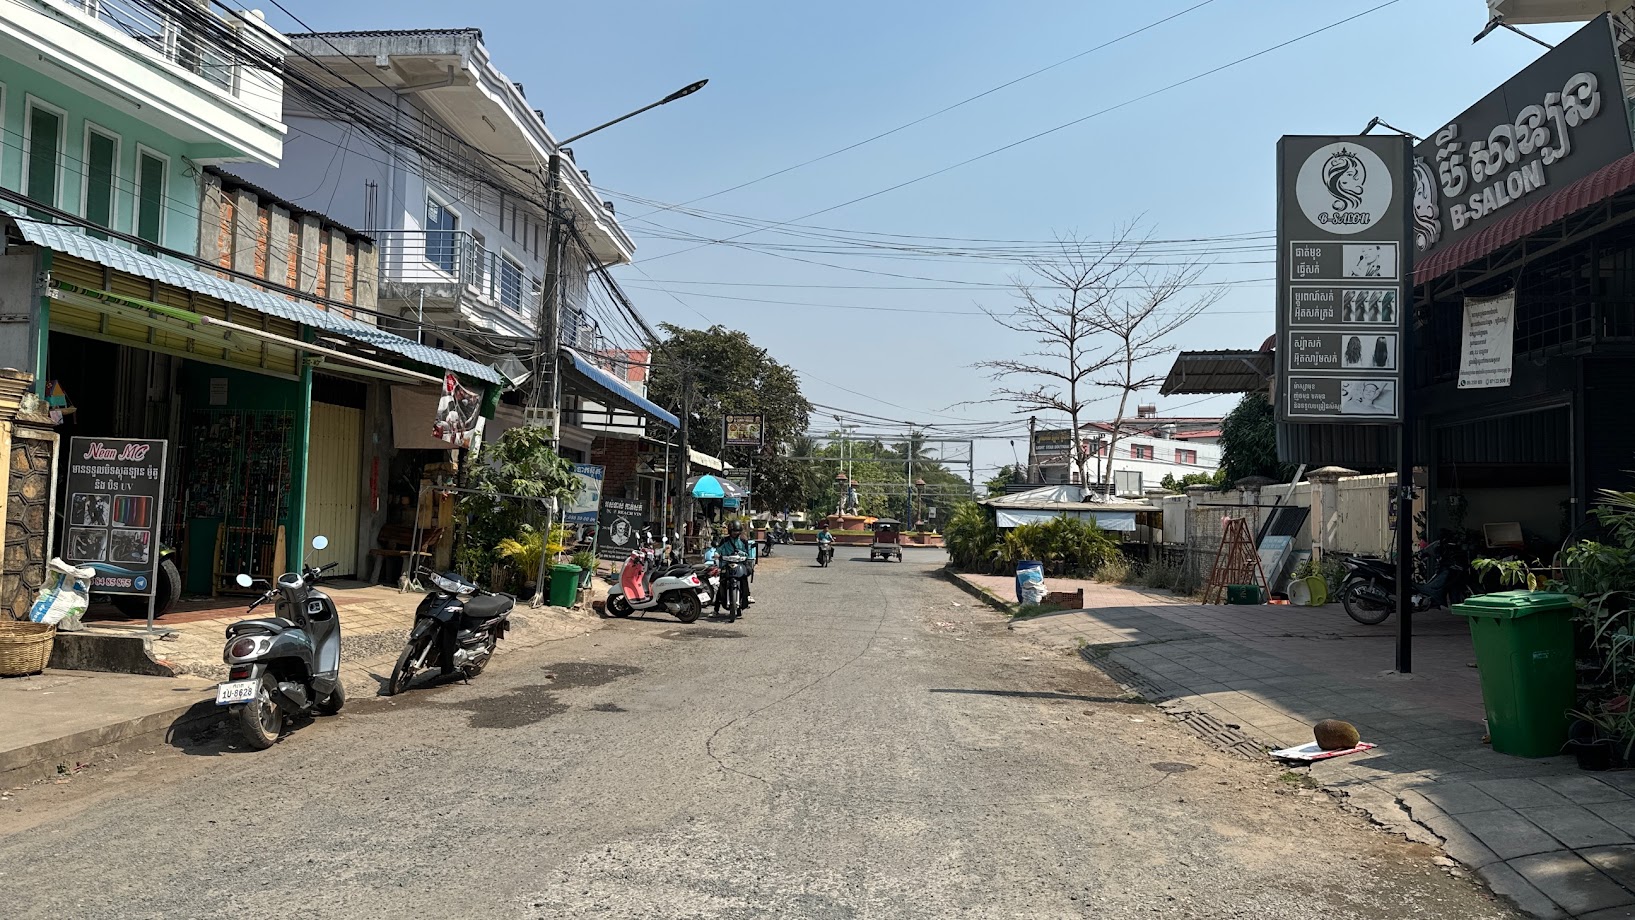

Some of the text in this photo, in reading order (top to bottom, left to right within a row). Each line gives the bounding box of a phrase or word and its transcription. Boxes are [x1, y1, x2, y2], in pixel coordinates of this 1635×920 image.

[1450, 159, 1546, 231] B-SALON
[1318, 212, 1370, 225] B-SALON
[118, 443, 150, 461] MC
[94, 479, 105, 490] និង
[121, 482, 133, 490] UV
[222, 688, 252, 699] 1U-8628
